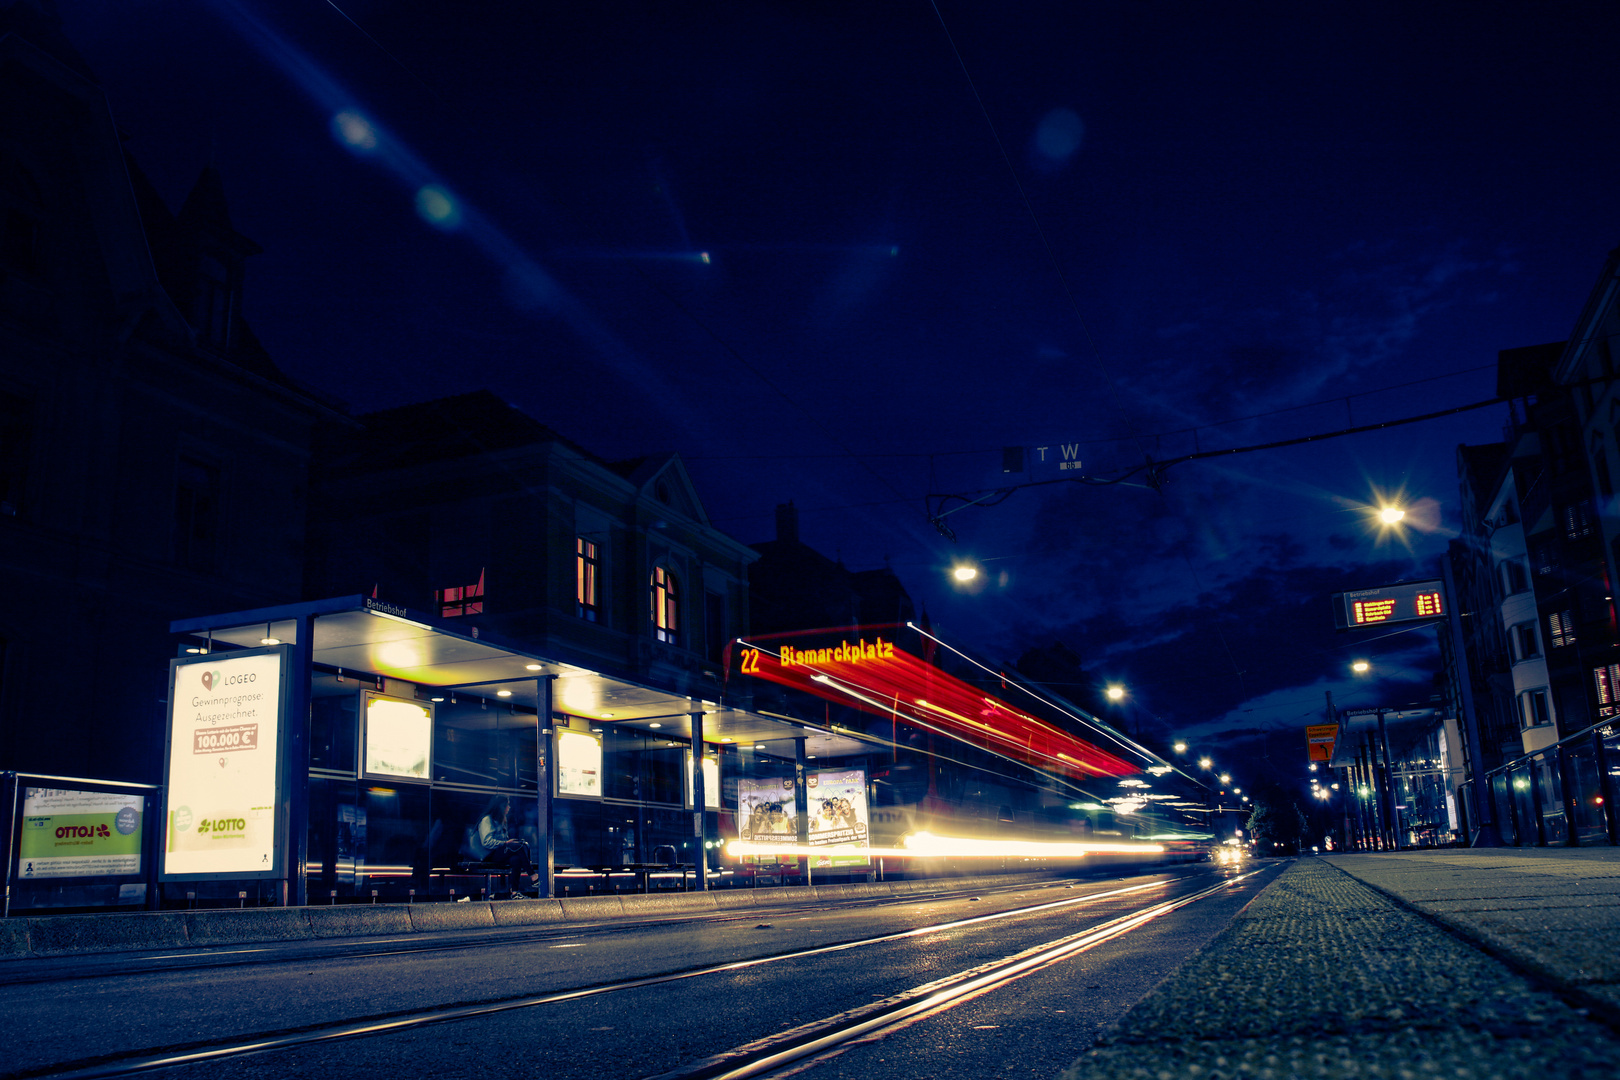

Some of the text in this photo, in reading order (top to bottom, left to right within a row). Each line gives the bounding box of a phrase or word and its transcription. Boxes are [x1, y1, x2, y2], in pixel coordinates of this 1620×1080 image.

[1037, 443, 1079, 461] T W
[1350, 589, 1380, 598] Betriebshof
[366, 598, 407, 617] Betriebshof
[740, 636, 894, 673] 22 Bismarckplatz
[224, 673, 257, 686] LOGEO
[191, 693, 264, 707] Gewinnprognose:
[195, 709, 258, 725] Ausgezeichnet.
[1346, 708, 1378, 716] Betriebshof
[197, 732, 240, 748] 100.000
[212, 818, 246, 832] LOTTO
